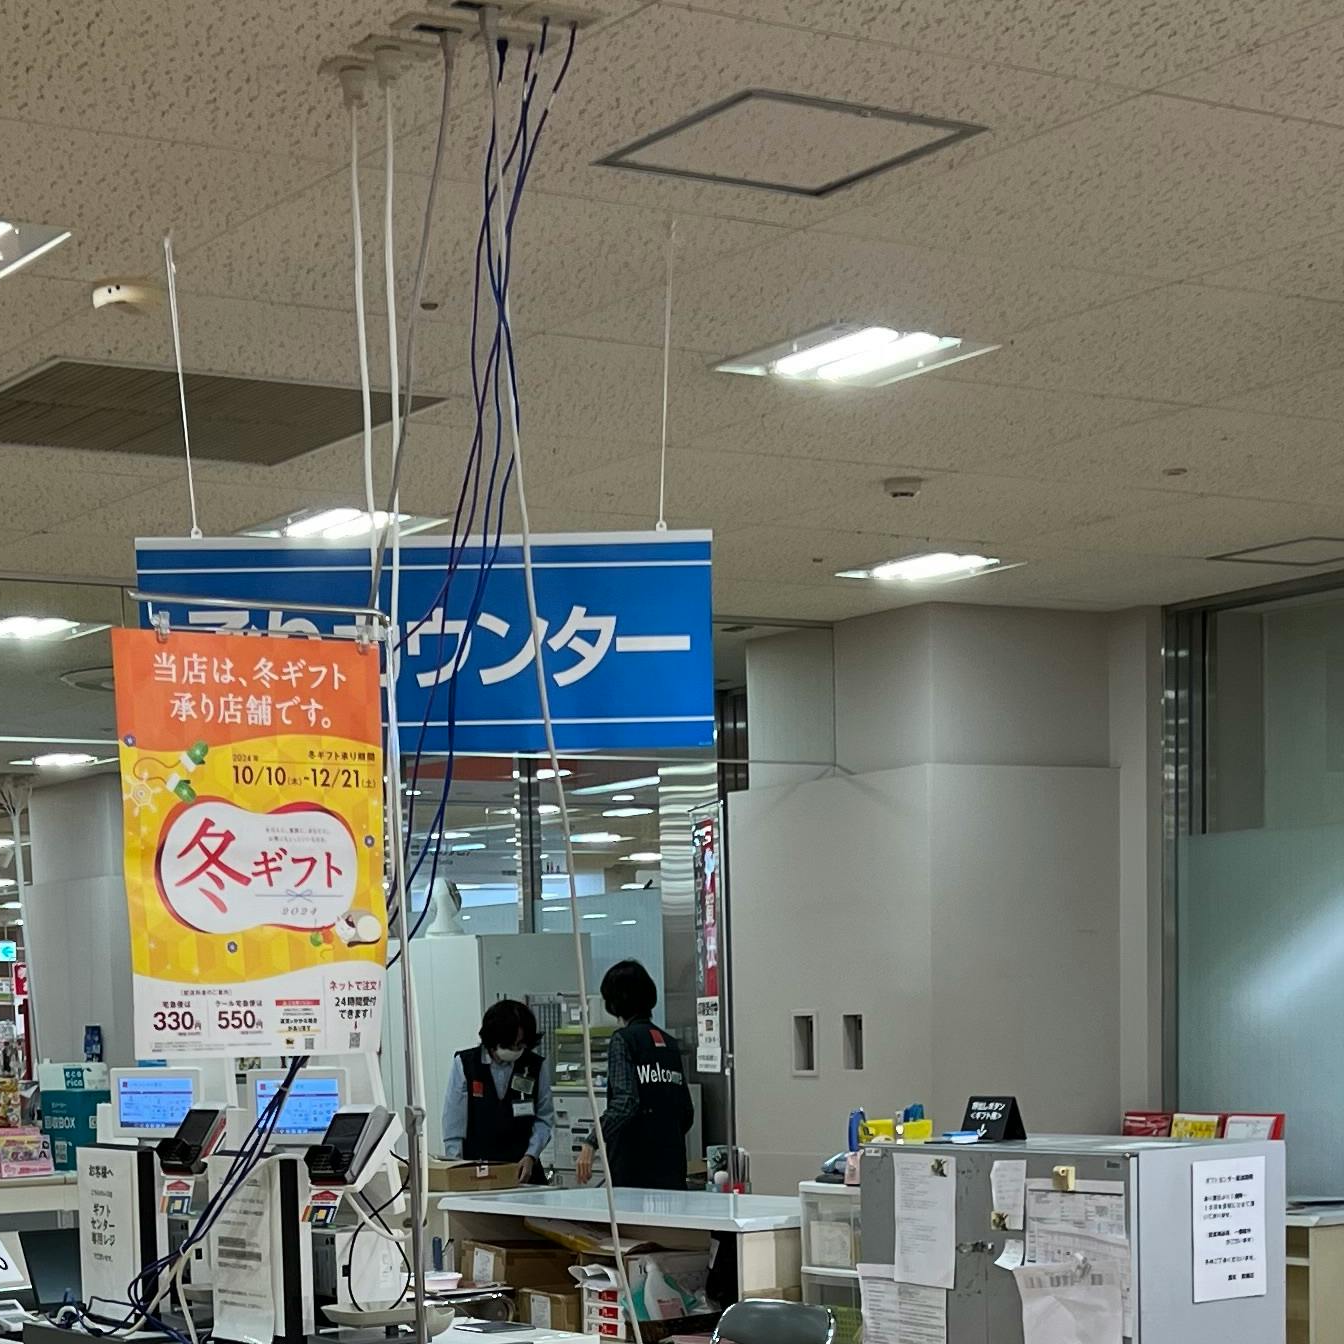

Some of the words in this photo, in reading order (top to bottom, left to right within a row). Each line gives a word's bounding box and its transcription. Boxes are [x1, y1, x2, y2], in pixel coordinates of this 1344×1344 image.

[189, 605, 690, 687] ウンター
[153, 652, 347, 690] 当店は、冬ギフト
[169, 692, 332, 728] 承り店舗です。
[175, 818, 343, 914] 冬ギフト
[281, 907, 319, 916] 2024
[329, 980, 382, 991] ネットで注文!
[153, 1011, 202, 1031] 330円
[217, 1010, 264, 1030] 550円
[339, 1008, 373, 1019] できます!
[88, 1164, 114, 1179] お客様へ
[92, 1203, 111, 1217] ギフト
[90, 1217, 115, 1231] センター
